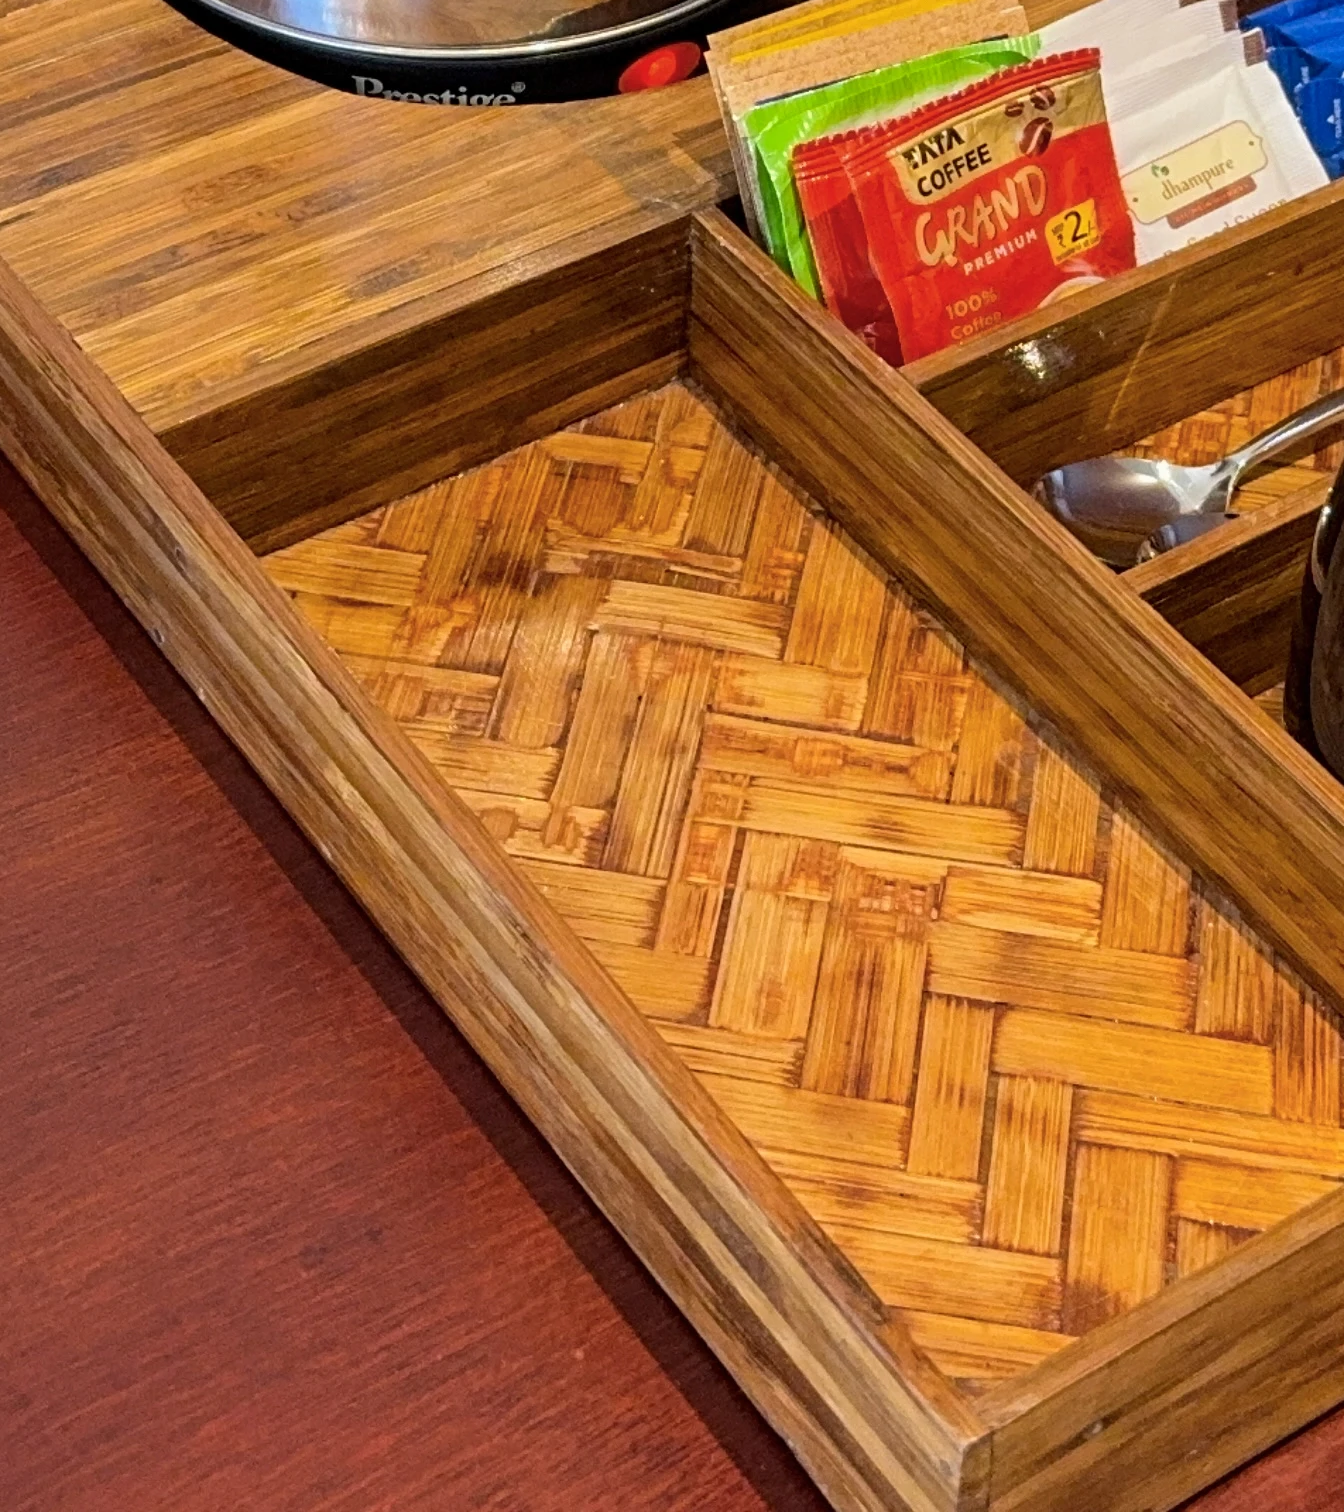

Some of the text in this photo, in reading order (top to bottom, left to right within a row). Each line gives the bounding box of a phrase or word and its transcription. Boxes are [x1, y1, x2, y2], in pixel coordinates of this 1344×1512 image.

[901, 126, 966, 170] TATA
[916, 143, 992, 197] COFFEE
[1160, 157, 1235, 201] dhampure
[915, 164, 1047, 267] GRAND
[962, 228, 1038, 277] PREMIUM
[945, 286, 998, 320] 100%
[950, 311, 1002, 340] Coffee
